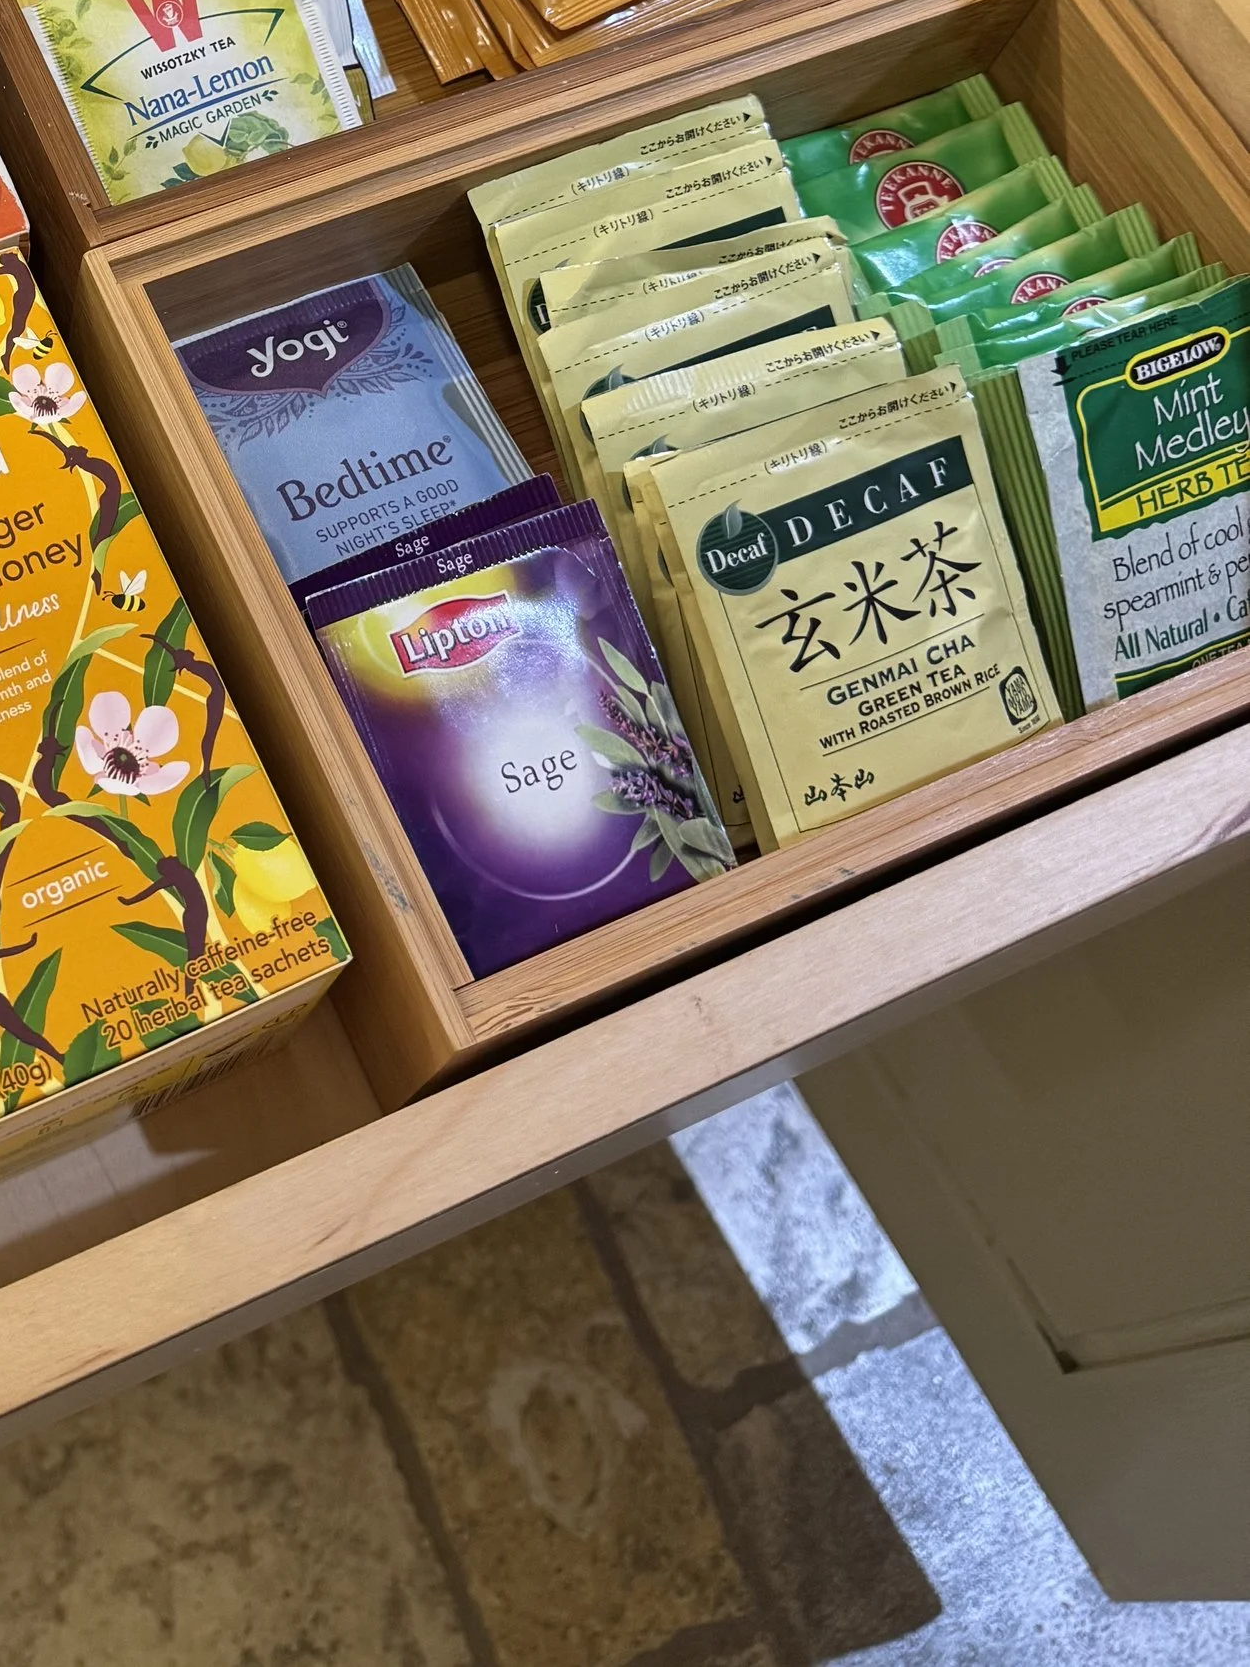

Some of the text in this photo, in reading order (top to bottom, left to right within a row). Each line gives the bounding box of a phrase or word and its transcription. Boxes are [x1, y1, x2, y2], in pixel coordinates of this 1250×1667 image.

[140, 36, 236, 80] WISSOTZKY TEA
[124, 55, 274, 127] Nana-Lemon
[159, 95, 262, 143] MAGIC GARDEN
[639, 113, 741, 156] ここからお開けください
[666, 157, 764, 200] ここからお開けください
[593, 209, 655, 238] (キリトリ線)
[247, 319, 350, 378] yogi
[1134, 336, 1222, 381] BIGELOW
[1153, 373, 1223, 425] Mint
[1134, 412, 1250, 471] Medley
[276, 440, 453, 522] Bedtime
[784, 457, 949, 548] DECAF
[1136, 455, 1250, 517] HERB TE
[316, 478, 459, 543] SUPPORTS A GOOD
[336, 523, 401, 556] NIGHT'S
[437, 551, 473, 575] Sage
[705, 533, 769, 575] Decaf
[1113, 506, 1242, 583] Blend of cool
[755, 520, 981, 673] 玄米茶
[1104, 567, 1221, 632] spearmint &
[34, 650, 48, 663] of
[401, 609, 509, 664] Lipton
[1114, 606, 1210, 662] All Natural
[26, 671, 52, 690] and
[827, 634, 976, 706] GENMAI CHA
[858, 664, 966, 717] GREEN TEA
[819, 663, 1000, 750] WITH ROASTED BROWN RICE
[500, 748, 578, 795] Sage
[20, 860, 110, 912] organic
[80, 909, 318, 1023] Naturally caffeine-free
[101, 937, 331, 1048] 20 herbal tea sachets
